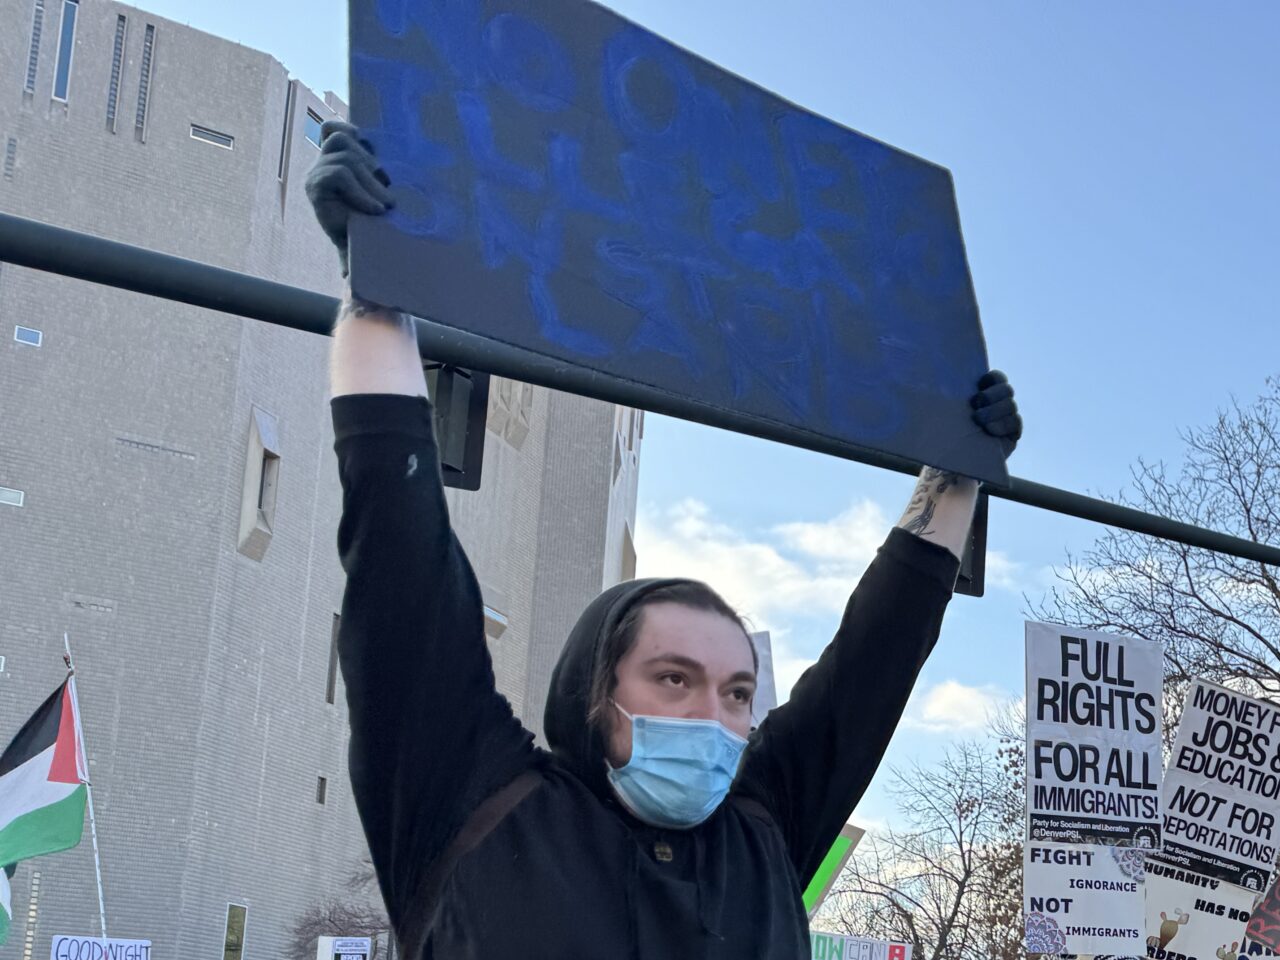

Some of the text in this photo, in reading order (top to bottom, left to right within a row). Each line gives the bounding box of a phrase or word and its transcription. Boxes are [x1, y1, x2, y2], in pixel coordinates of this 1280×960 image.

[1060, 635, 1135, 688] FULL
[1037, 678, 1156, 735] RIGHTS
[1193, 685, 1270, 729] MONEY
[1192, 716, 1270, 766] JOBS
[1034, 740, 1157, 790] FOR ALL
[1034, 785, 1159, 820] IMMIGRANTS!
[1169, 785, 1275, 840] NOT FOR
[1032, 819, 1050, 829] Party
[1050, 820, 1060, 828] for
[1060, 821, 1091, 830] Socialism
[1102, 824, 1130, 833] Liberation
[1032, 828, 1082, 839] @DenverPSL
[1031, 848, 1095, 866] FIGHT
[1154, 851, 1191, 866] DenverPSL
[1175, 847, 1202, 861] Socialism
[1213, 858, 1240, 872] Liberation
[1069, 879, 1137, 892] IGNORANCE
[1144, 862, 1220, 890] HUMANITY
[1030, 897, 1073, 913] NOT
[1194, 899, 1250, 922] HAS NO
[1066, 926, 1139, 938] IMMIGRANTS
